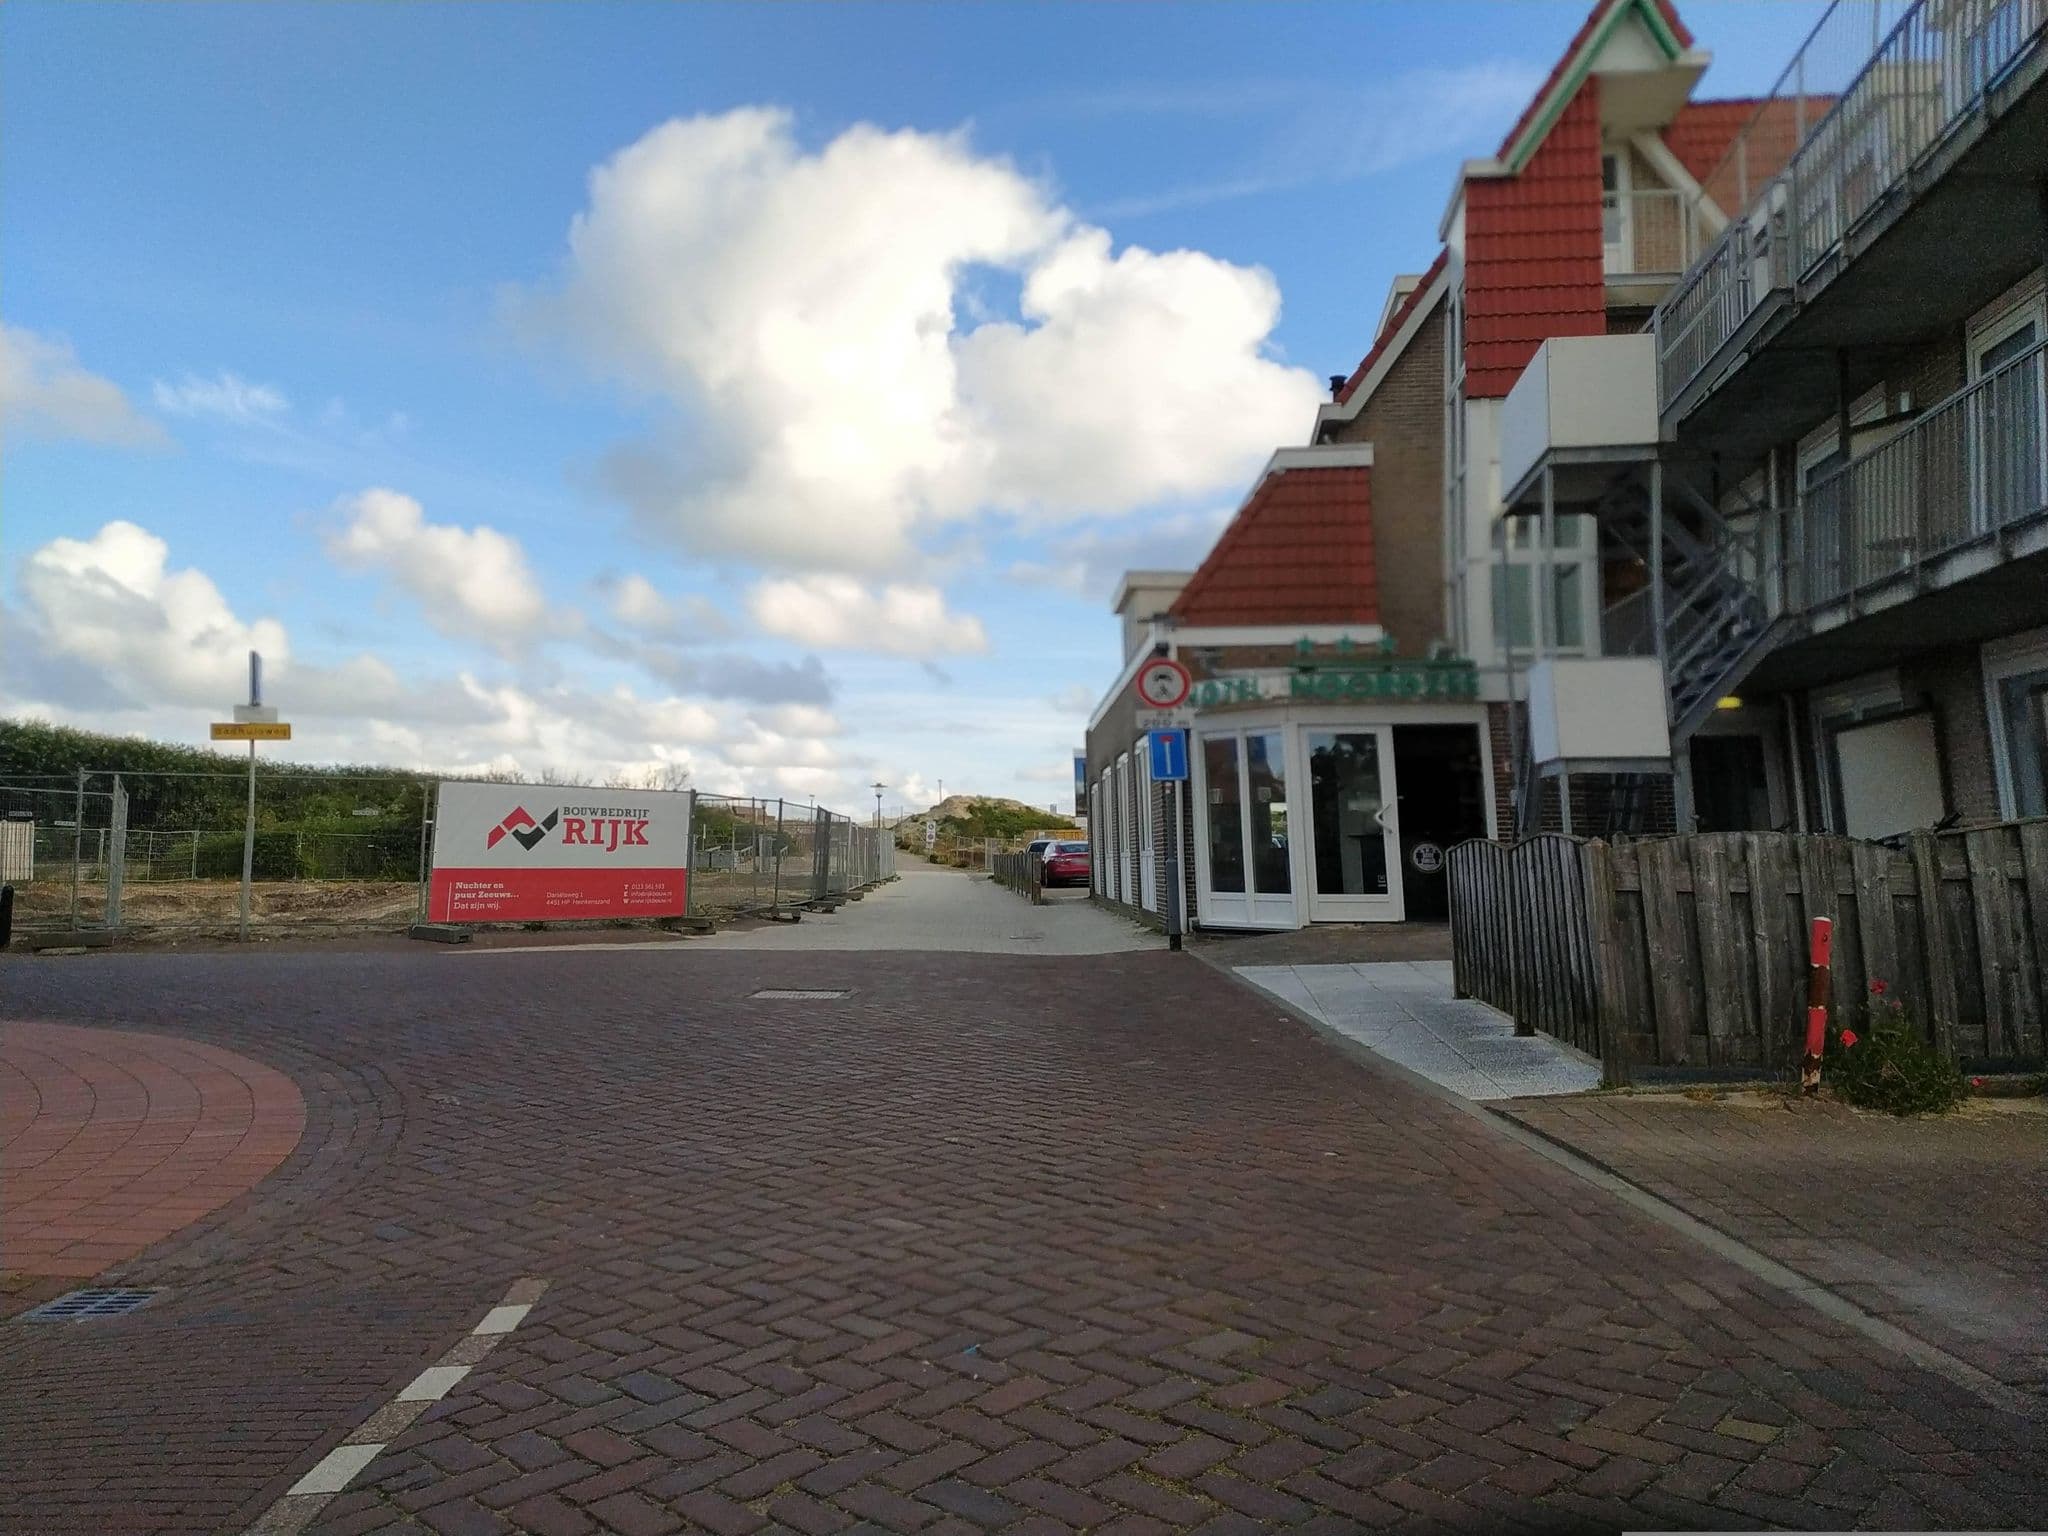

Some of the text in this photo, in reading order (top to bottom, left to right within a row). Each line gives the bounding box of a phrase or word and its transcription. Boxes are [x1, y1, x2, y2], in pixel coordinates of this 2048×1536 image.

[563, 806, 650, 819] BOUWBEDRIJF
[562, 818, 649, 852] RIJK
[454, 892, 477, 900] puur
[453, 901, 501, 911] Dat zijn wij.
